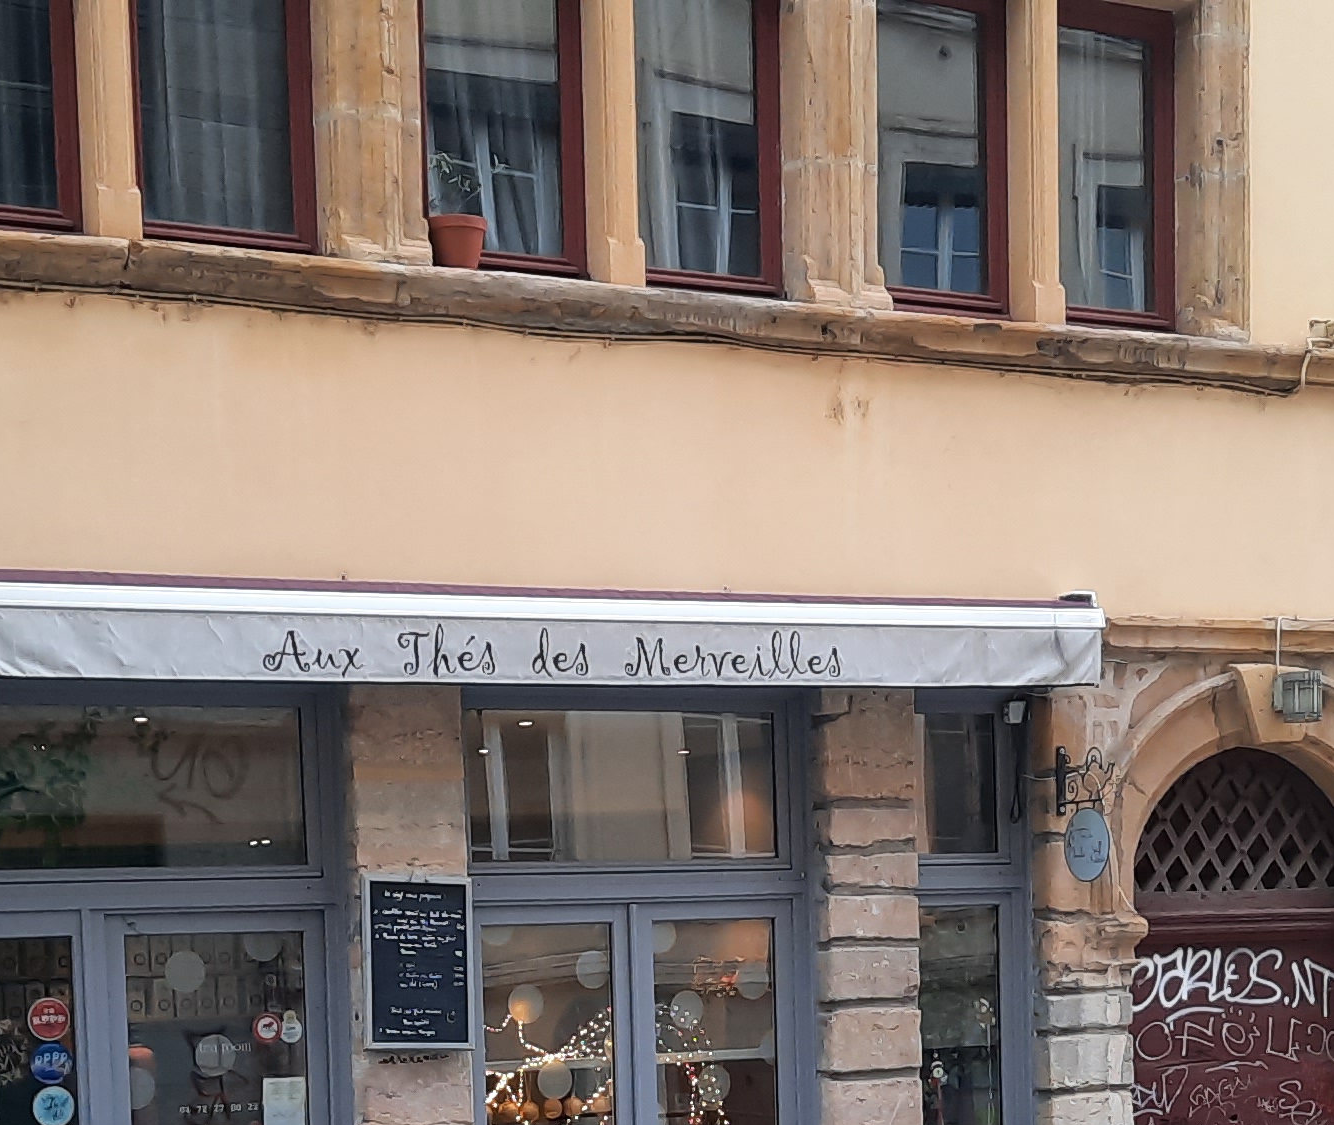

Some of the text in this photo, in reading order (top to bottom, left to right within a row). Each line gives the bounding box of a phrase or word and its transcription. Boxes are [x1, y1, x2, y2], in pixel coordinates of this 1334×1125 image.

[263, 623, 841, 679] Aux Thés des Merveilles
